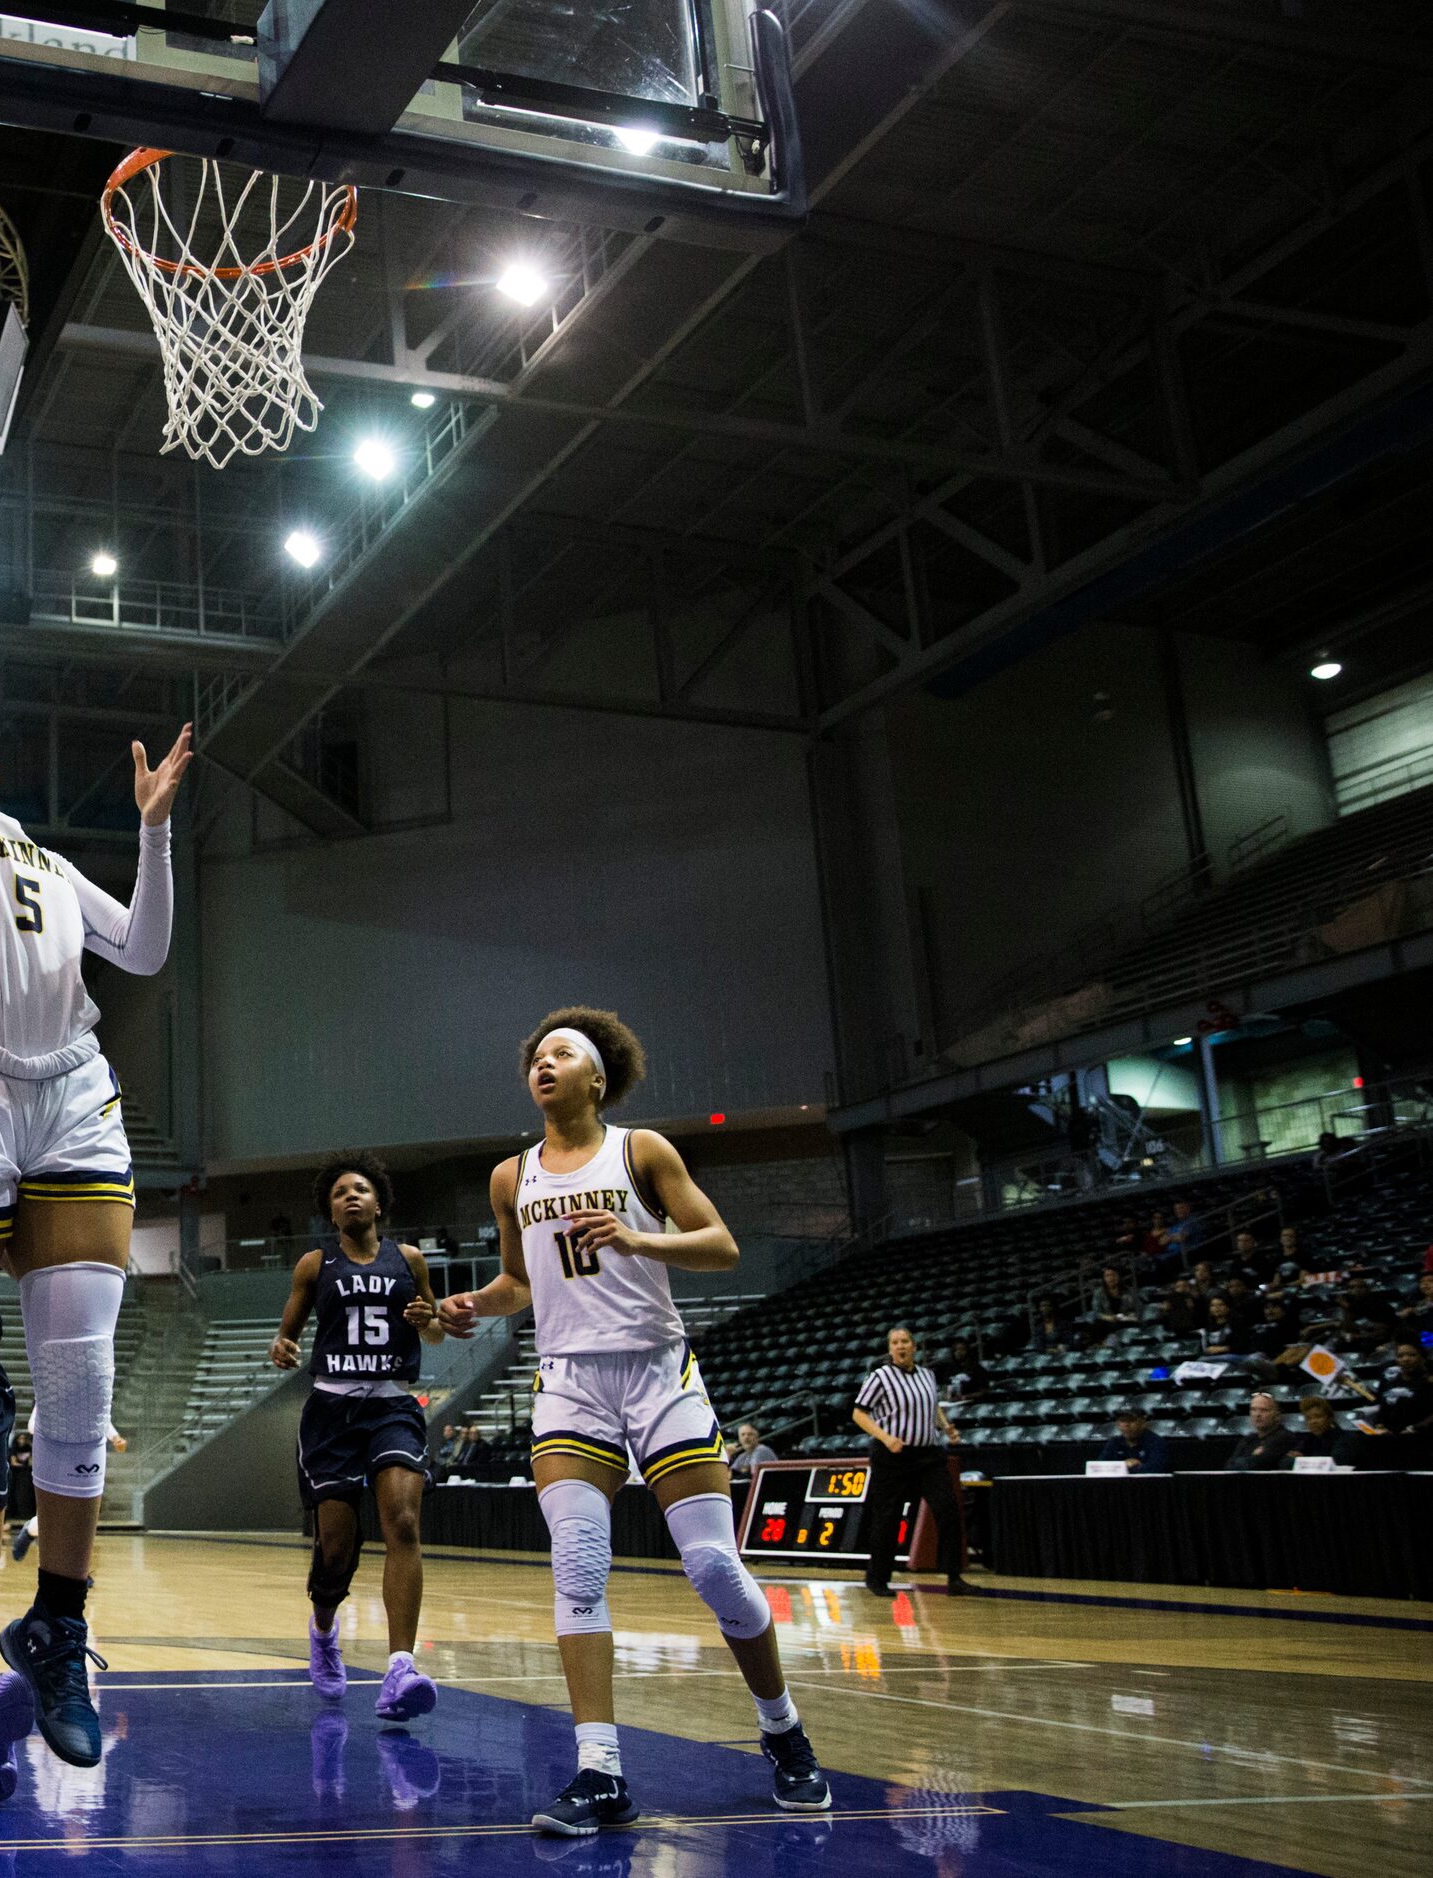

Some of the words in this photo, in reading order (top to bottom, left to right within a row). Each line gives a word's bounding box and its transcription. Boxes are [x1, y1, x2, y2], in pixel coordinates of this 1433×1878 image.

[15, 873, 44, 934] 5
[519, 1189, 629, 1229] MCKINNEY
[553, 1227, 601, 1280] 10
[335, 1274, 397, 1297] LADY
[345, 1305, 390, 1346] 15
[828, 1471, 866, 1496] 1:50
[819, 1522, 834, 1546] 2
